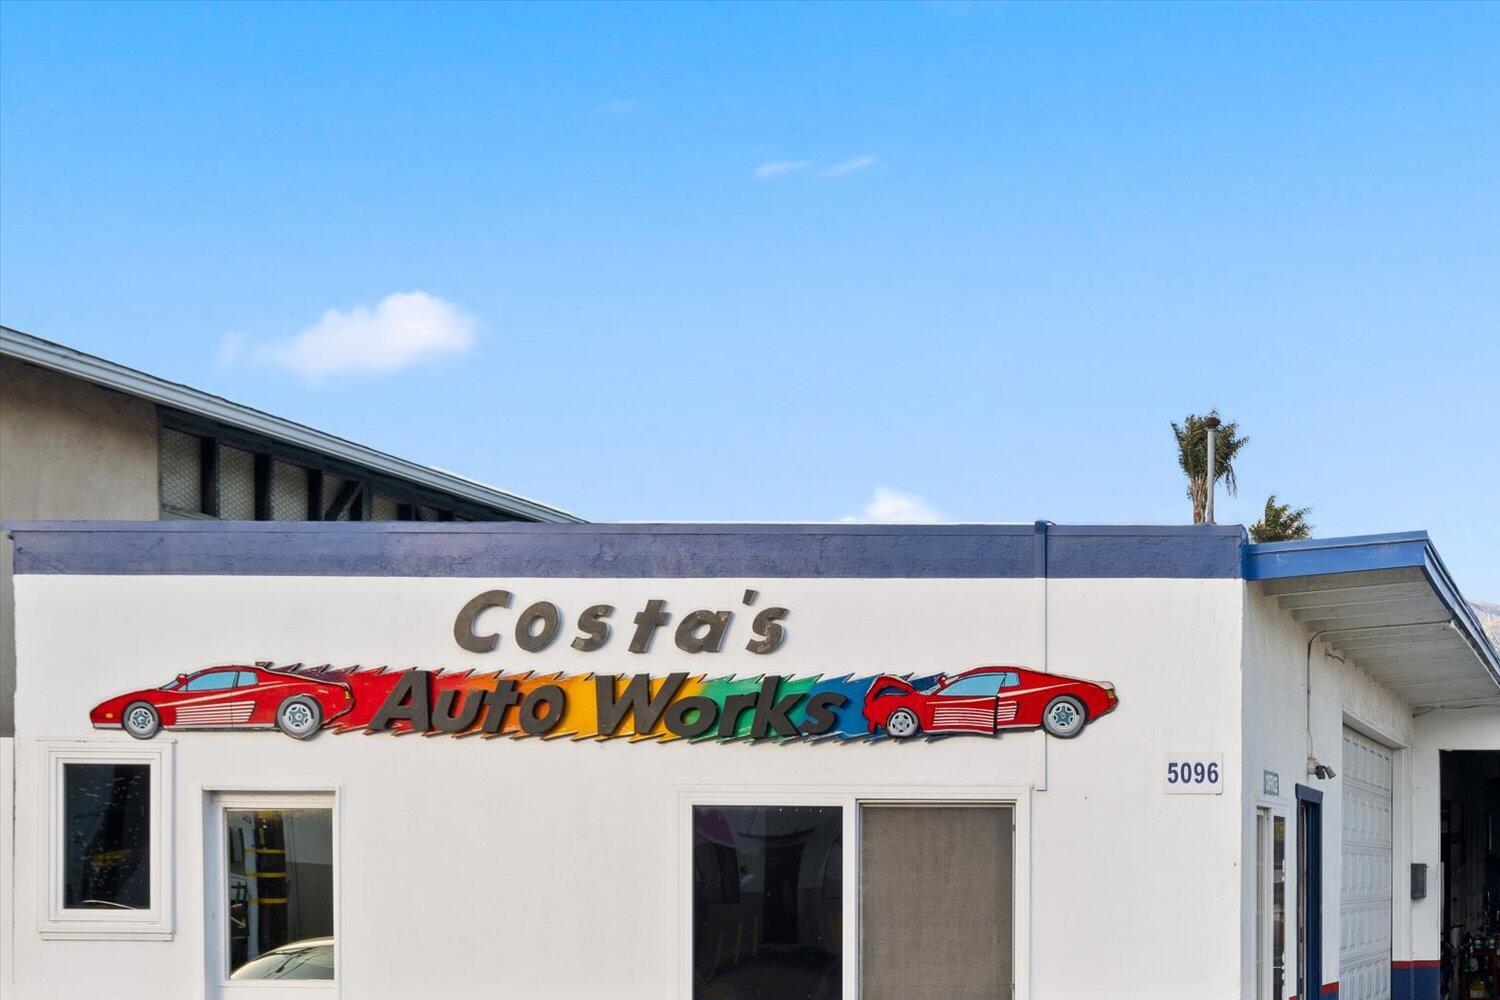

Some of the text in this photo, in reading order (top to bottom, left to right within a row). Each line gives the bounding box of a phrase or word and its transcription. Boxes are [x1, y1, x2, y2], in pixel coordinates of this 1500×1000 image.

[453, 589, 789, 654] Costa's
[368, 670, 849, 739] Auto Works
[1167, 762, 1219, 784] 5096
